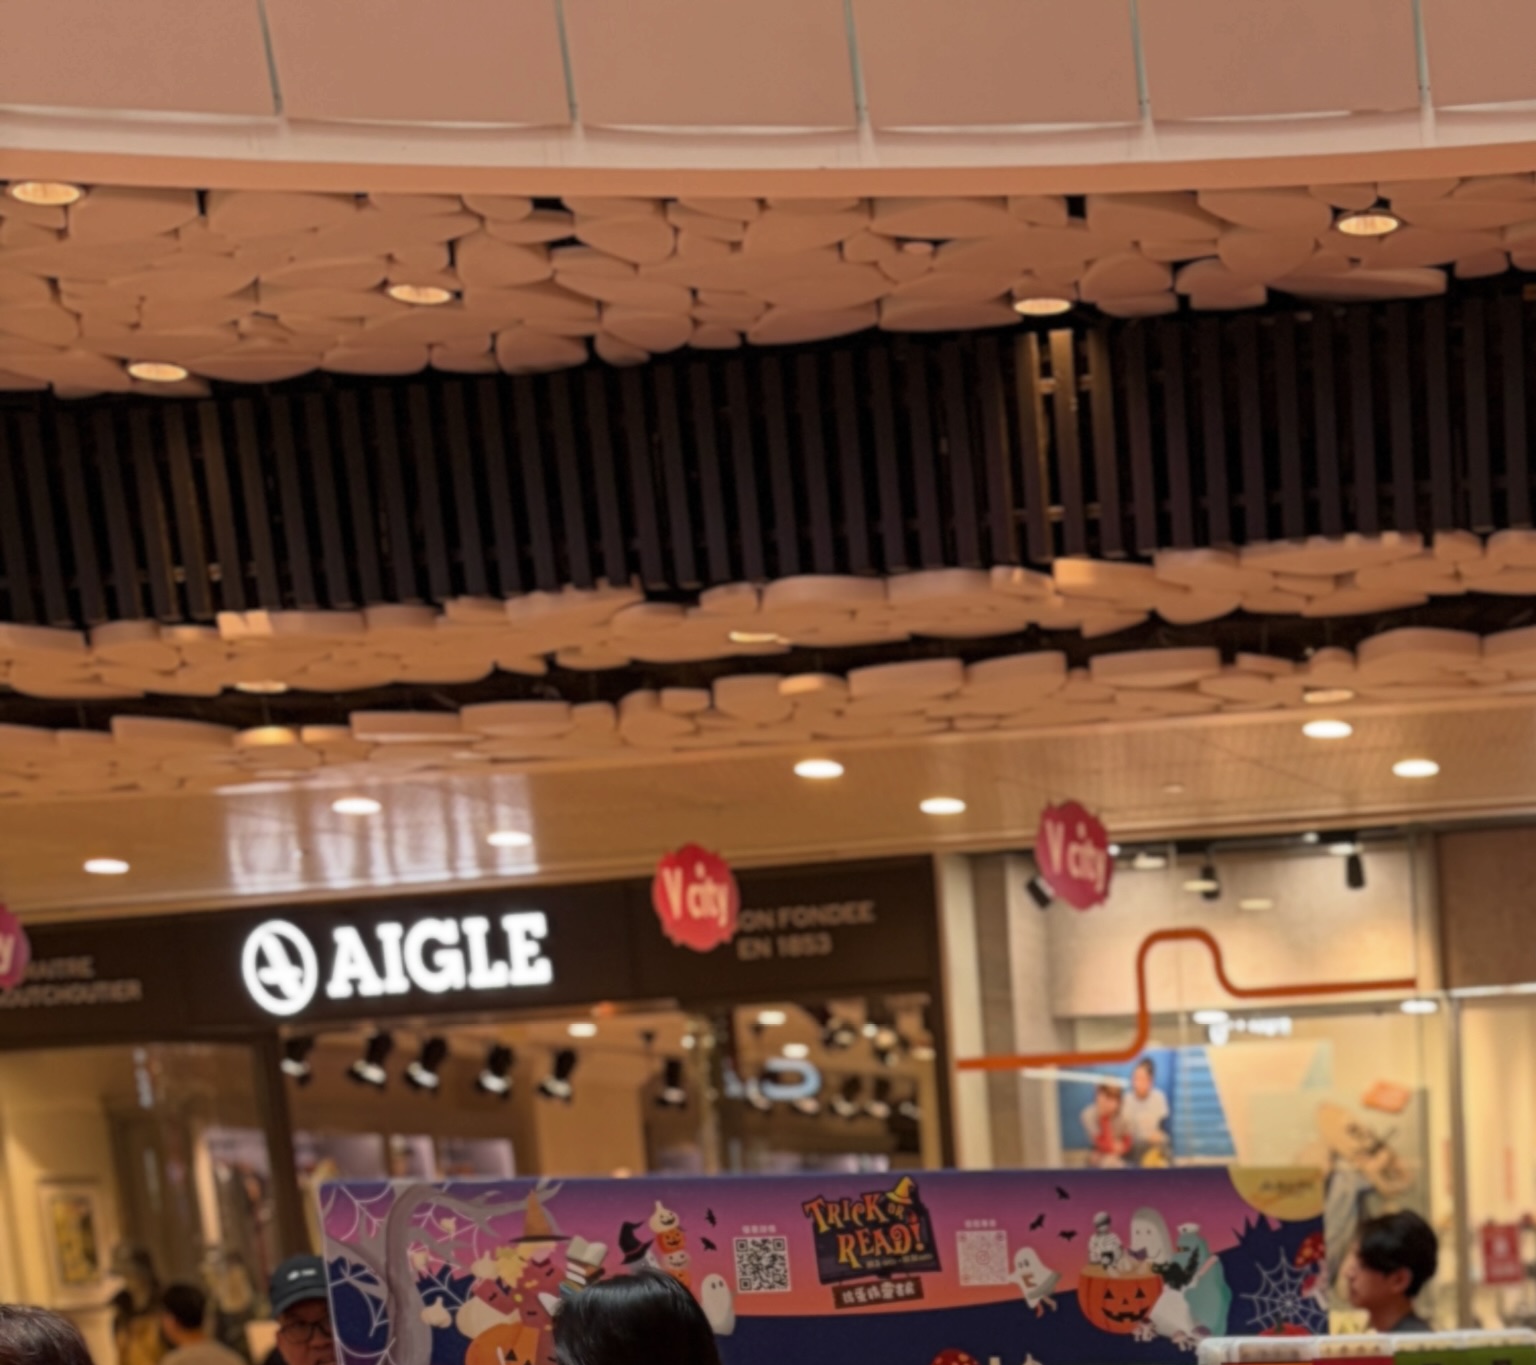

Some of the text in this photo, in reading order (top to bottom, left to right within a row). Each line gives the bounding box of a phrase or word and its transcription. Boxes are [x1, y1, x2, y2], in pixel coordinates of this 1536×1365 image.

[1065, 822, 1113, 887] city
[686, 861, 729, 928] city
[327, 911, 553, 1000] AIGLE
